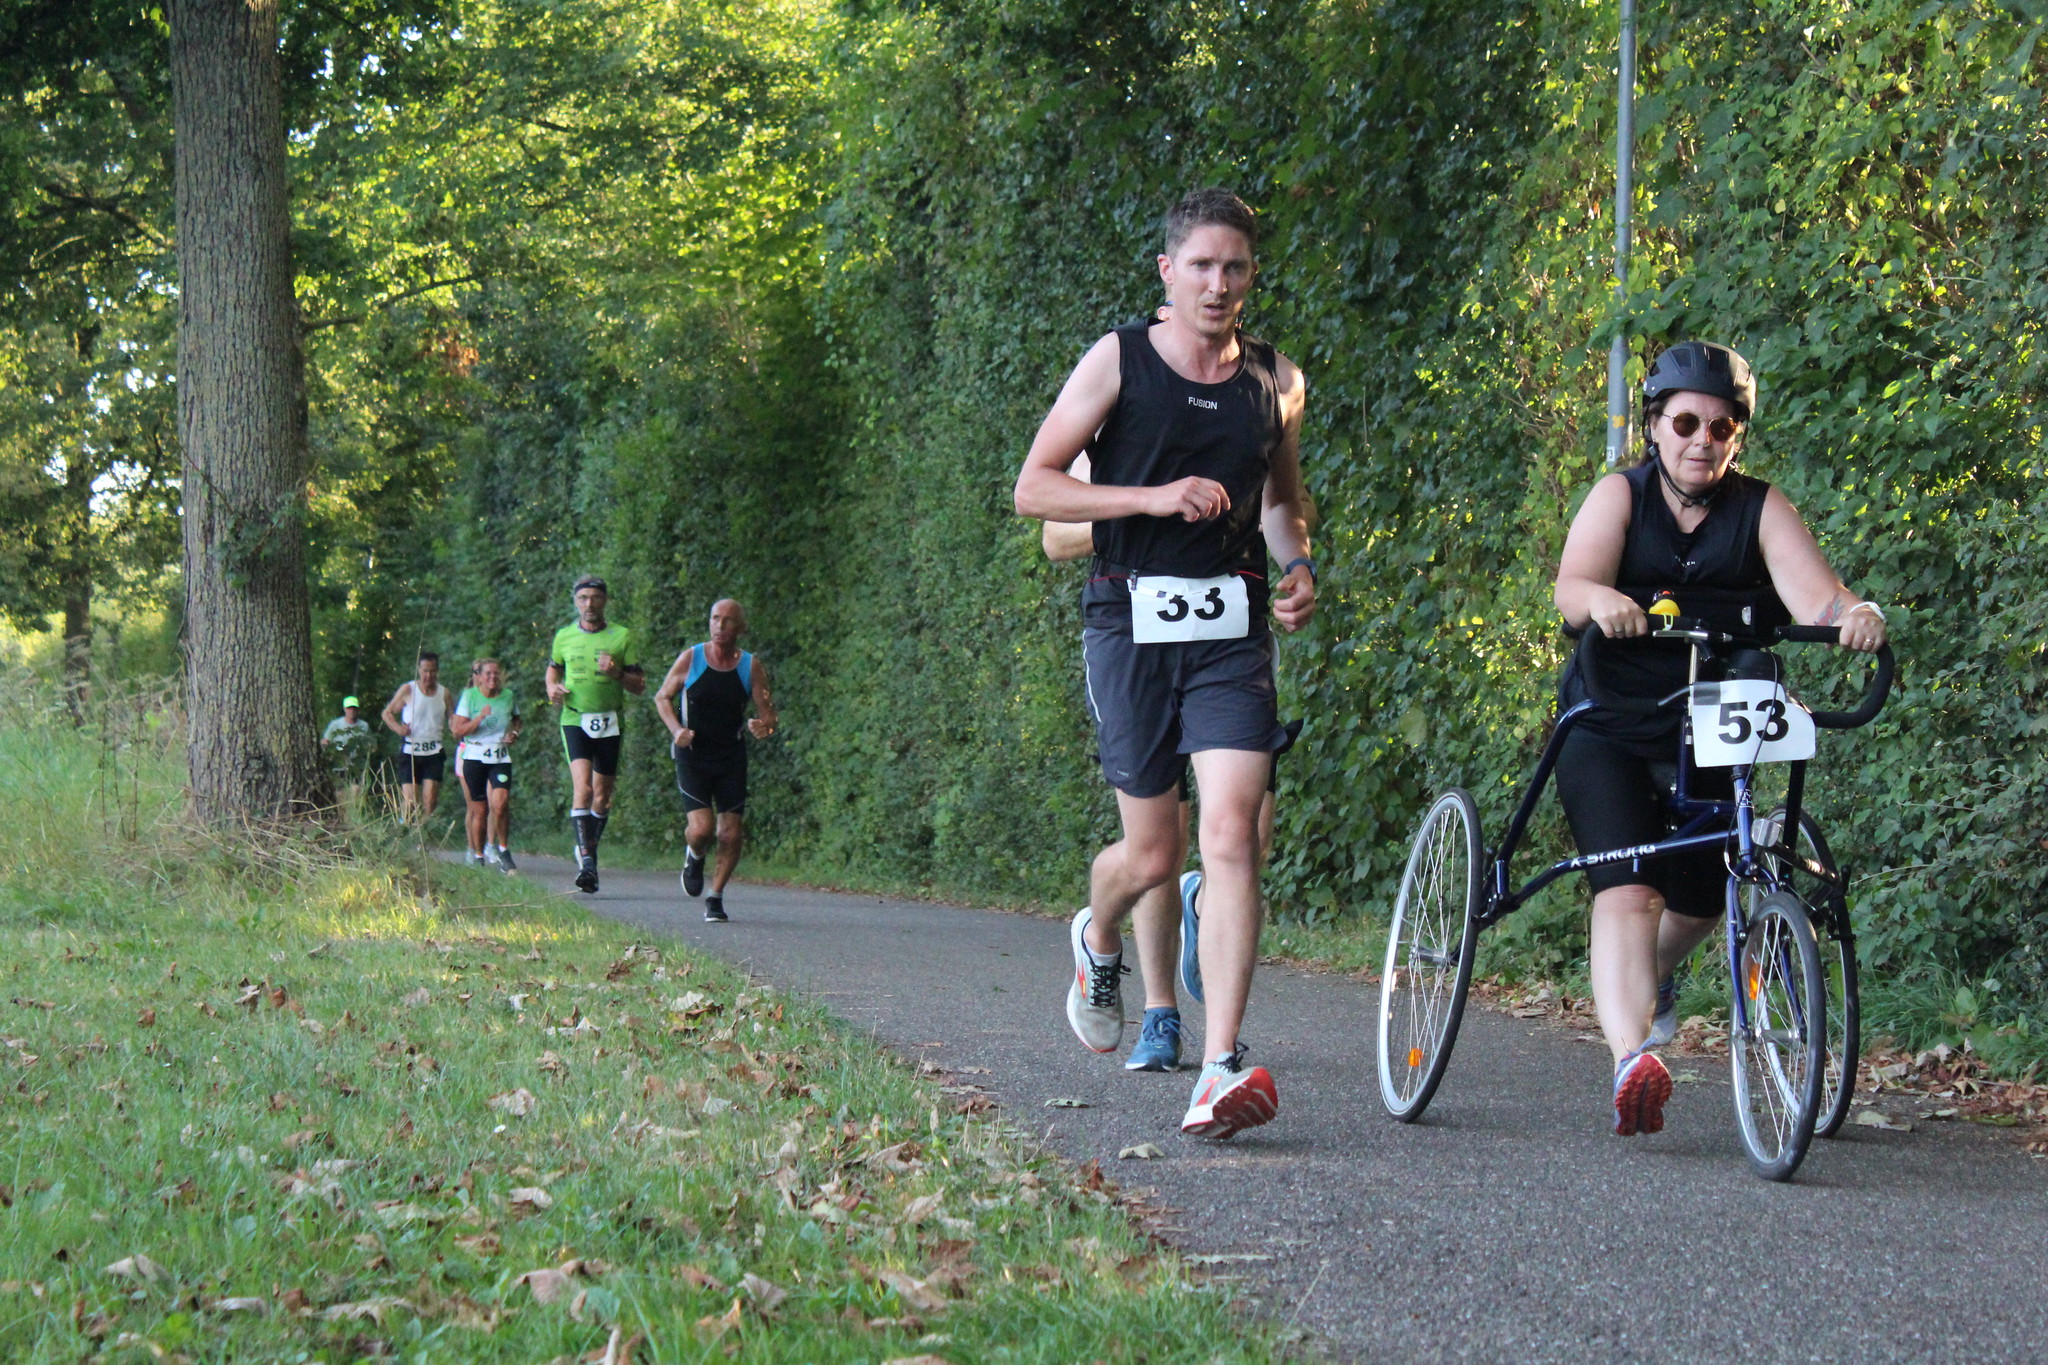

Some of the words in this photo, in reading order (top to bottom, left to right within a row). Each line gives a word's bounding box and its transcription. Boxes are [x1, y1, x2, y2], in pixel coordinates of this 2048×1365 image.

[1188, 396, 1218, 410] FUSION
[1156, 587, 1225, 622] 33
[1718, 699, 1789, 745] 53
